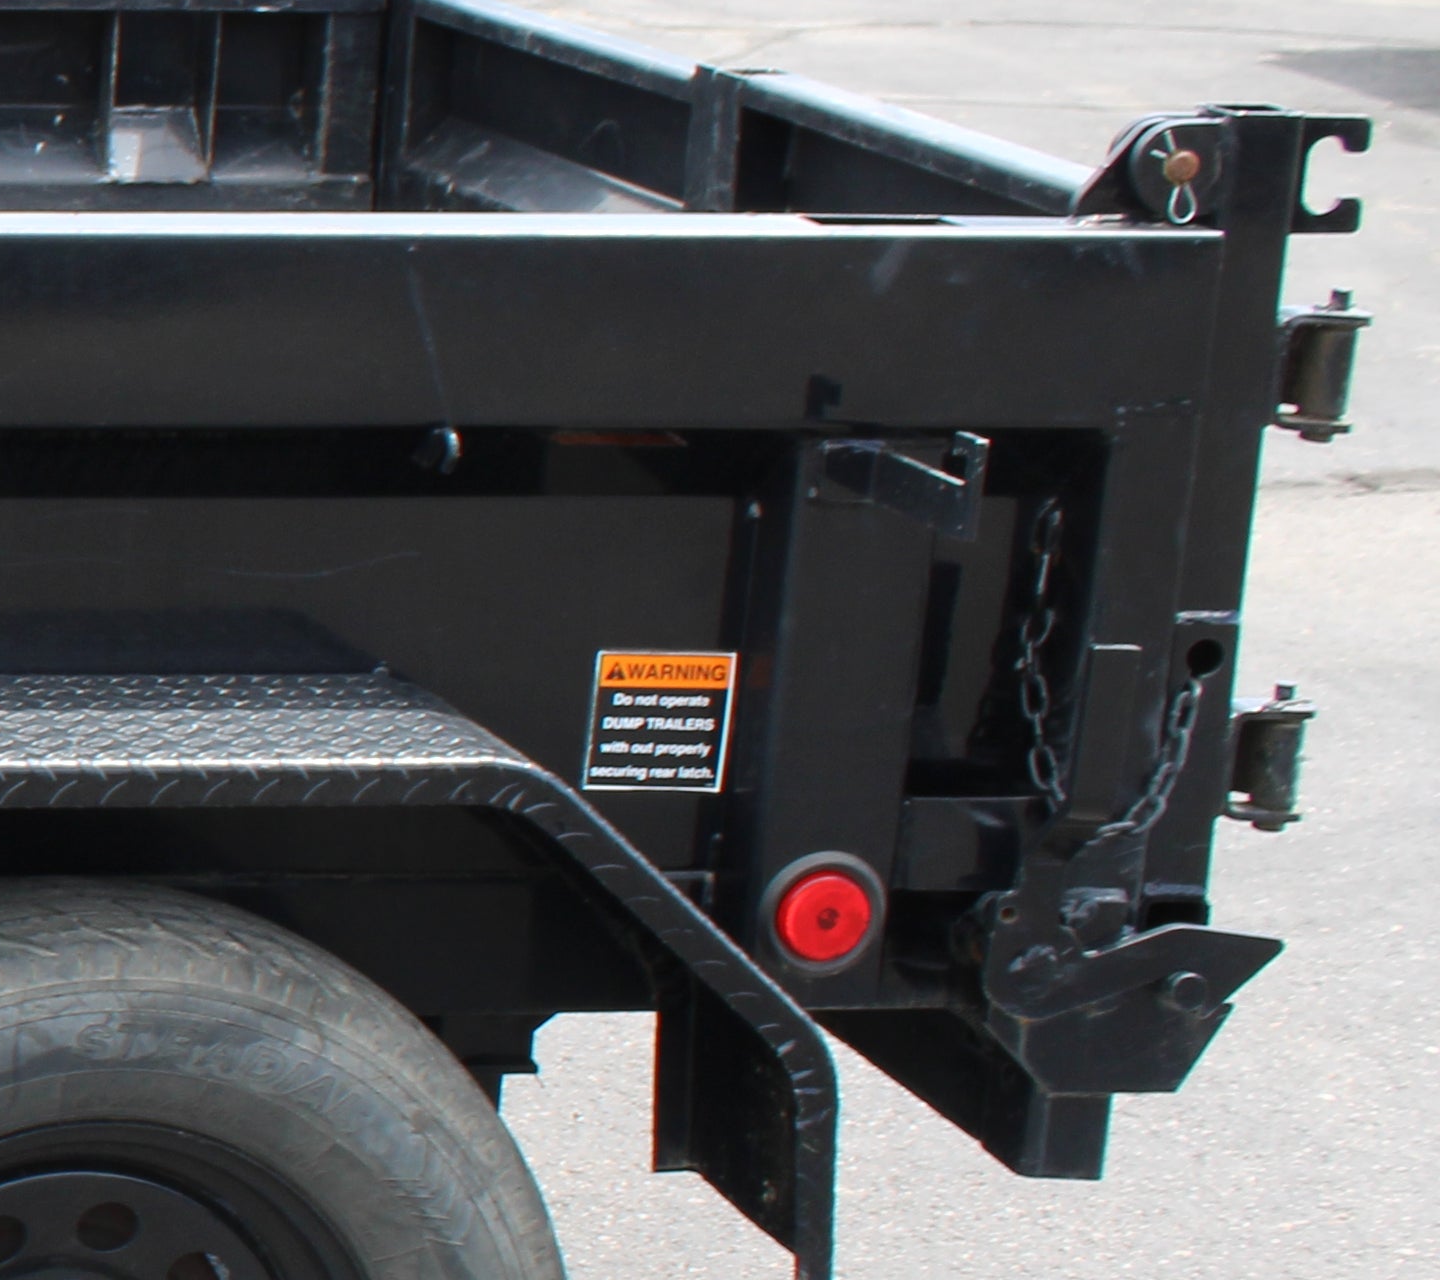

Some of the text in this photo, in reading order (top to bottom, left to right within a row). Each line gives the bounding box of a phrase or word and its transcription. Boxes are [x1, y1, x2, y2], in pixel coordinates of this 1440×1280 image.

[628, 663, 727, 682] WARNING
[612, 693, 711, 709] Do not operate
[602, 717, 715, 732] DUMP TRAILERS
[600, 741, 712, 758] with out properly
[590, 765, 714, 781] securing rear latch.
